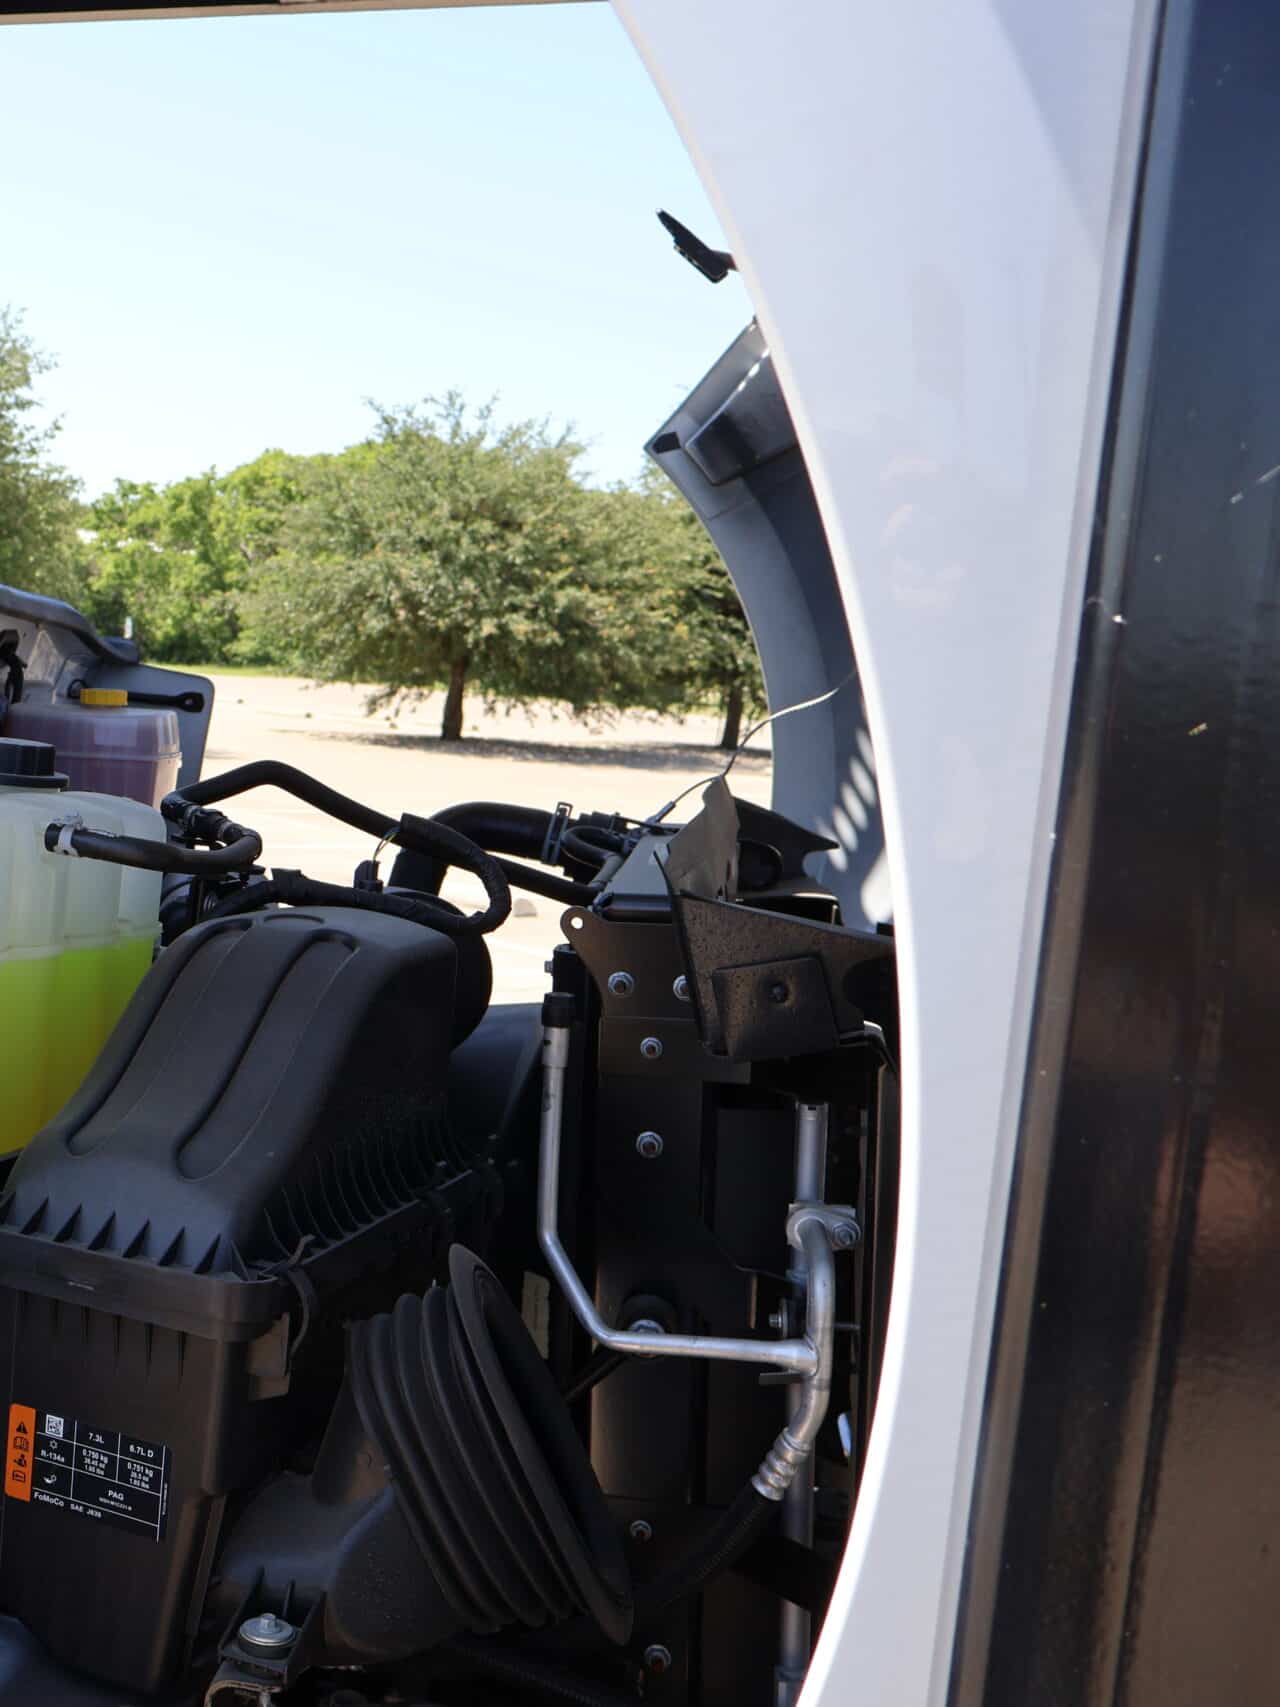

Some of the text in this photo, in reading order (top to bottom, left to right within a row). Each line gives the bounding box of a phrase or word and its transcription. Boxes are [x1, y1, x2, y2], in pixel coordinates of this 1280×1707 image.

[88, 1432, 104, 1444] 7.3L
[40, 1449, 64, 1463] R-134a
[129, 1444, 154, 1458] 6.7L D
[100, 1454, 108, 1464] kg
[145, 1467, 154, 1478] kg
[34, 1492, 64, 1507] FoMoCo
[108, 1489, 124, 1501] PAG
[70, 1503, 84, 1513] SAE
